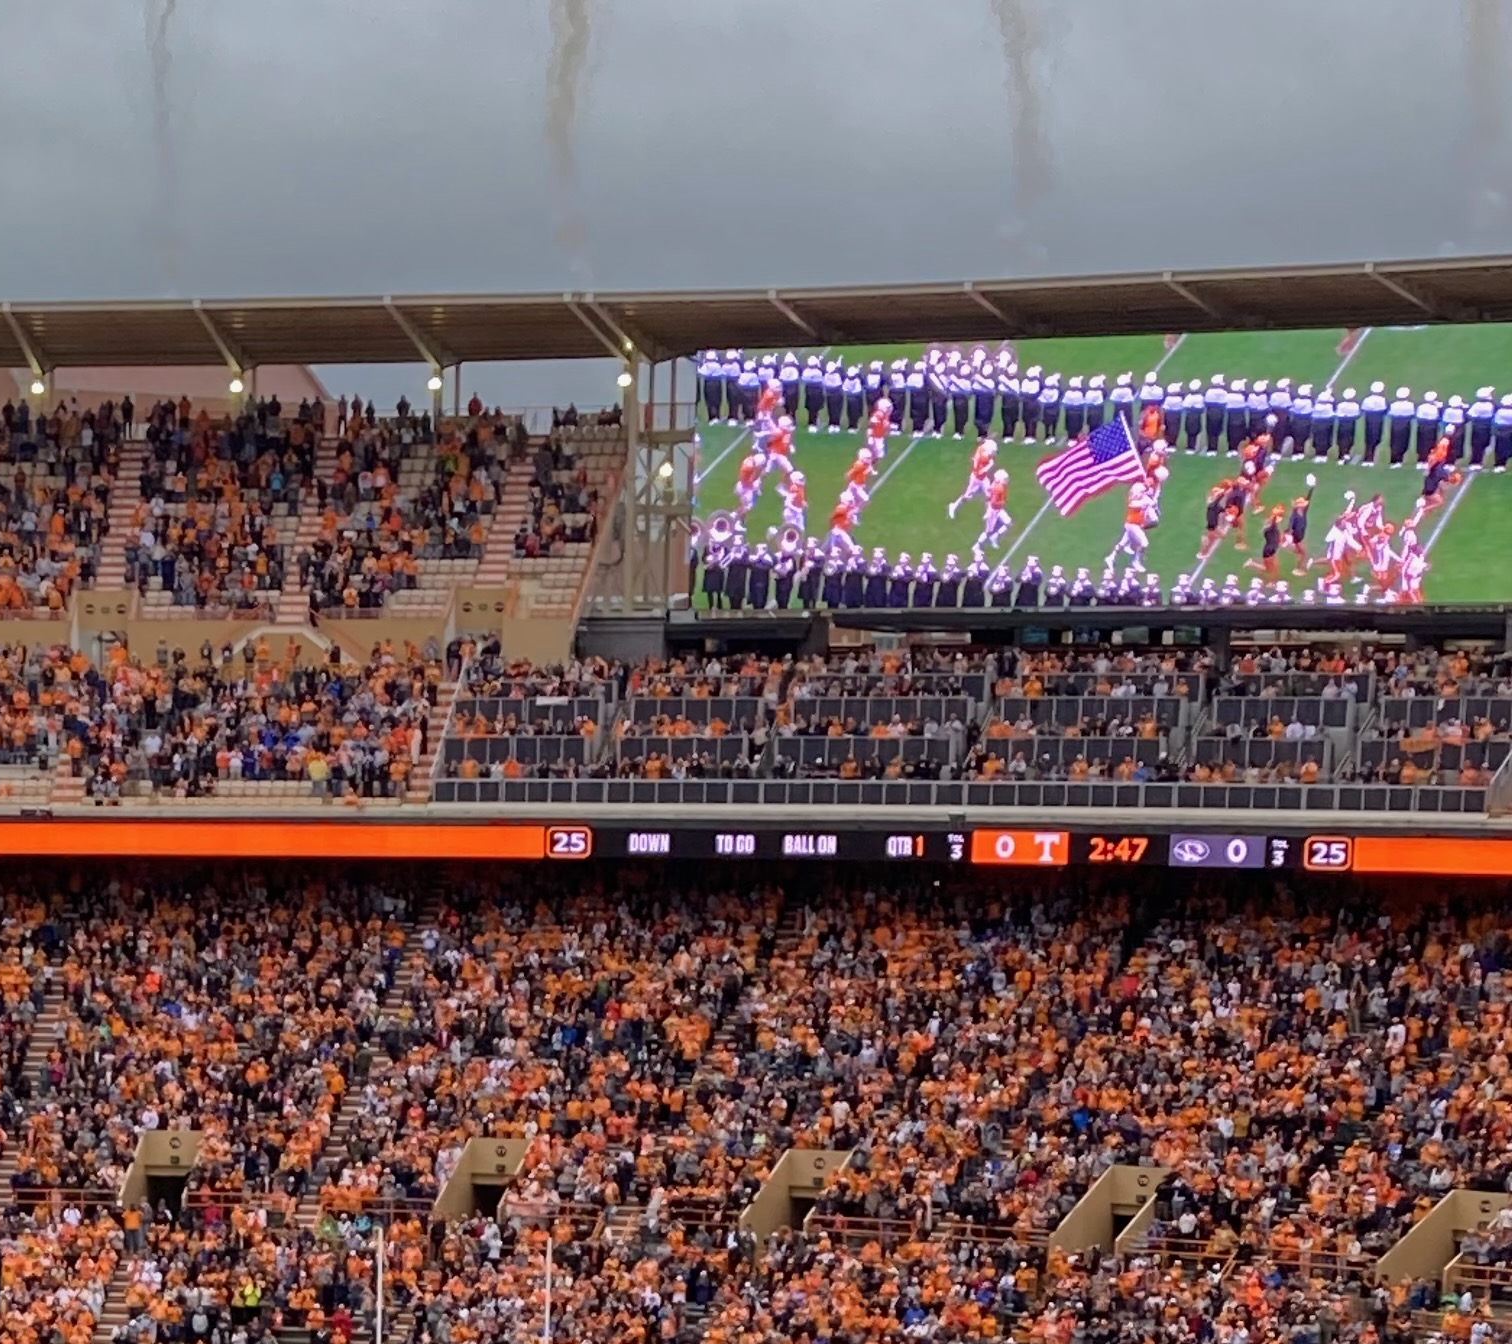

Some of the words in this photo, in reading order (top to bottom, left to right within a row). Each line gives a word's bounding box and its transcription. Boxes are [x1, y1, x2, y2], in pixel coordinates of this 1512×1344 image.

[552, 832, 586, 853] 25
[628, 833, 670, 853] DOWN
[715, 834, 732, 853] TO
[734, 834, 755, 854] GO
[783, 835, 813, 854] BALL
[817, 835, 836, 854] ON
[887, 836, 912, 856] QTR
[915, 835, 924, 857] 1
[950, 844, 963, 860] 3
[995, 835, 1014, 858] 0
[1034, 834, 1060, 863] T
[1089, 838, 1148, 862] 2:47
[1228, 838, 1247, 862] 0
[1272, 849, 1284, 866] 3
[1311, 843, 1346, 864] 25
